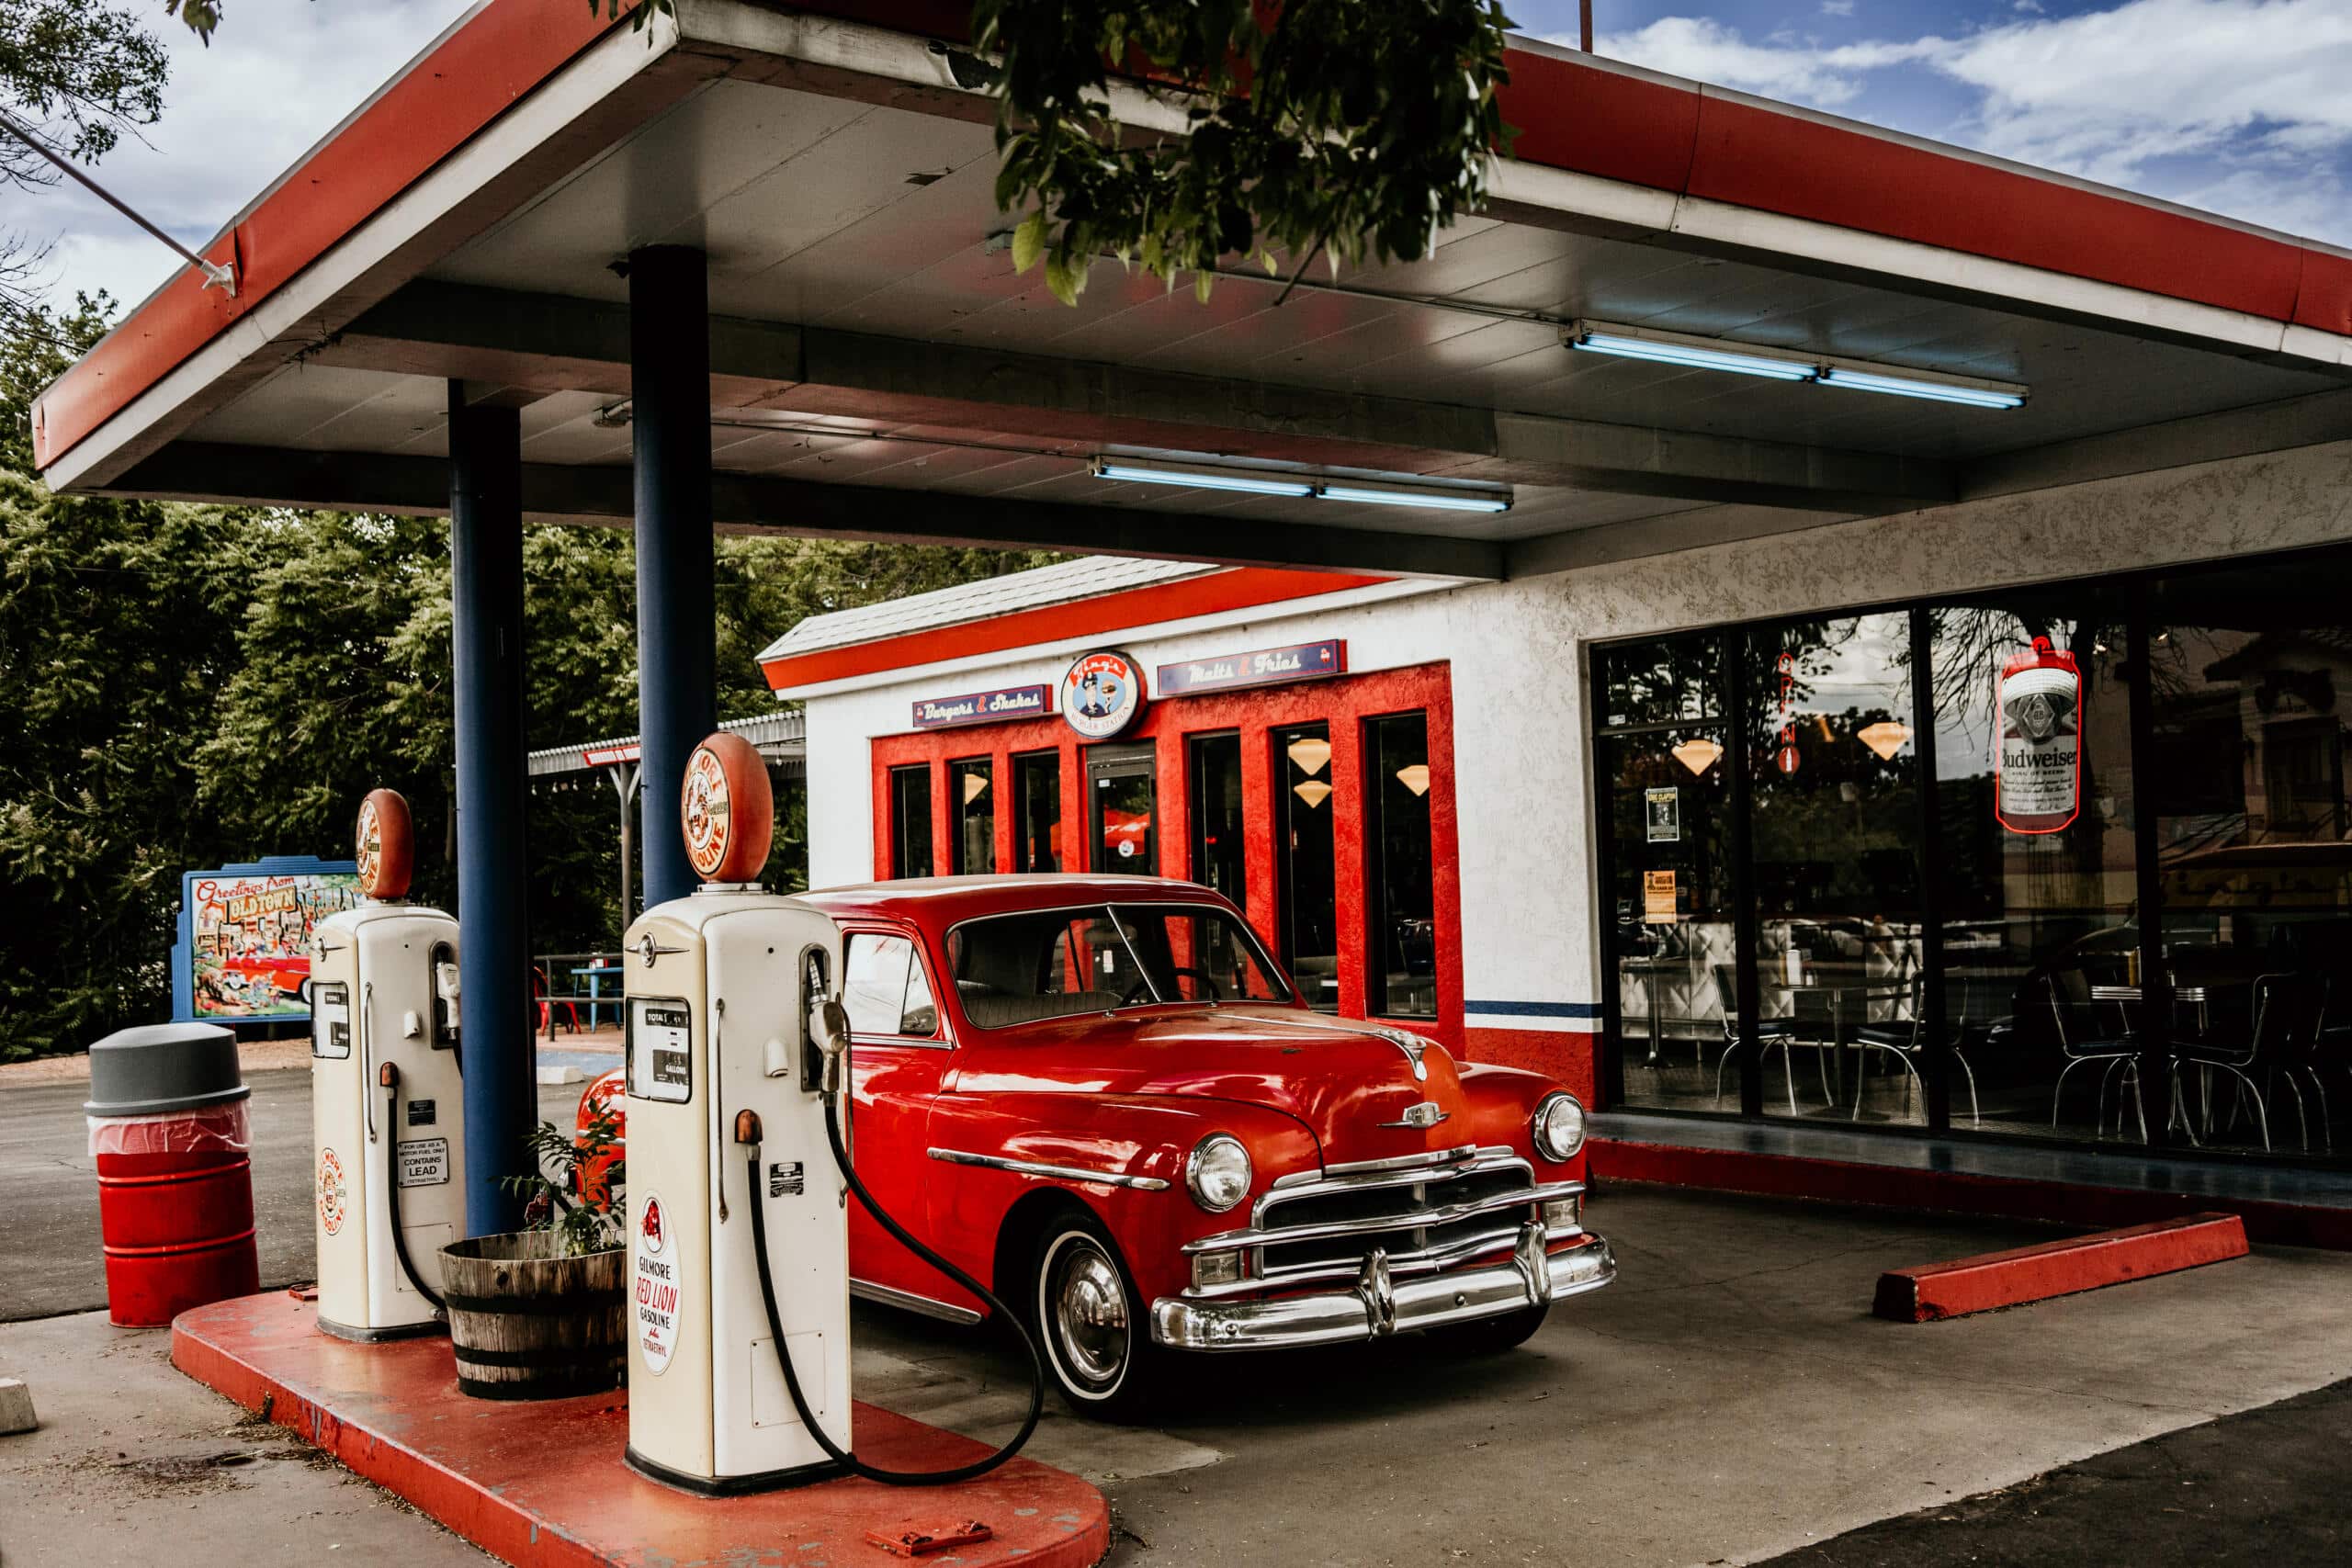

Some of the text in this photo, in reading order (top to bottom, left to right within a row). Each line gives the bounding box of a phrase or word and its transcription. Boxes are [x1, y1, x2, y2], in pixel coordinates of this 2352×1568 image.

[1188, 653, 1302, 684] Malts & Fries
[924, 692, 1040, 721] Burgers & Shakes
[1778, 652, 1796, 745] OPEN
[197, 875, 295, 908] Greetings from
[231, 895, 258, 919] OLD
[259, 887, 295, 914] TOWN
[404, 1156, 441, 1166] CONTAINS
[409, 1166, 436, 1177] LEAD
[639, 1256, 671, 1280] GILMORE
[636, 1276, 678, 1314] RED LION
[639, 1306, 671, 1330] GASOLINE
